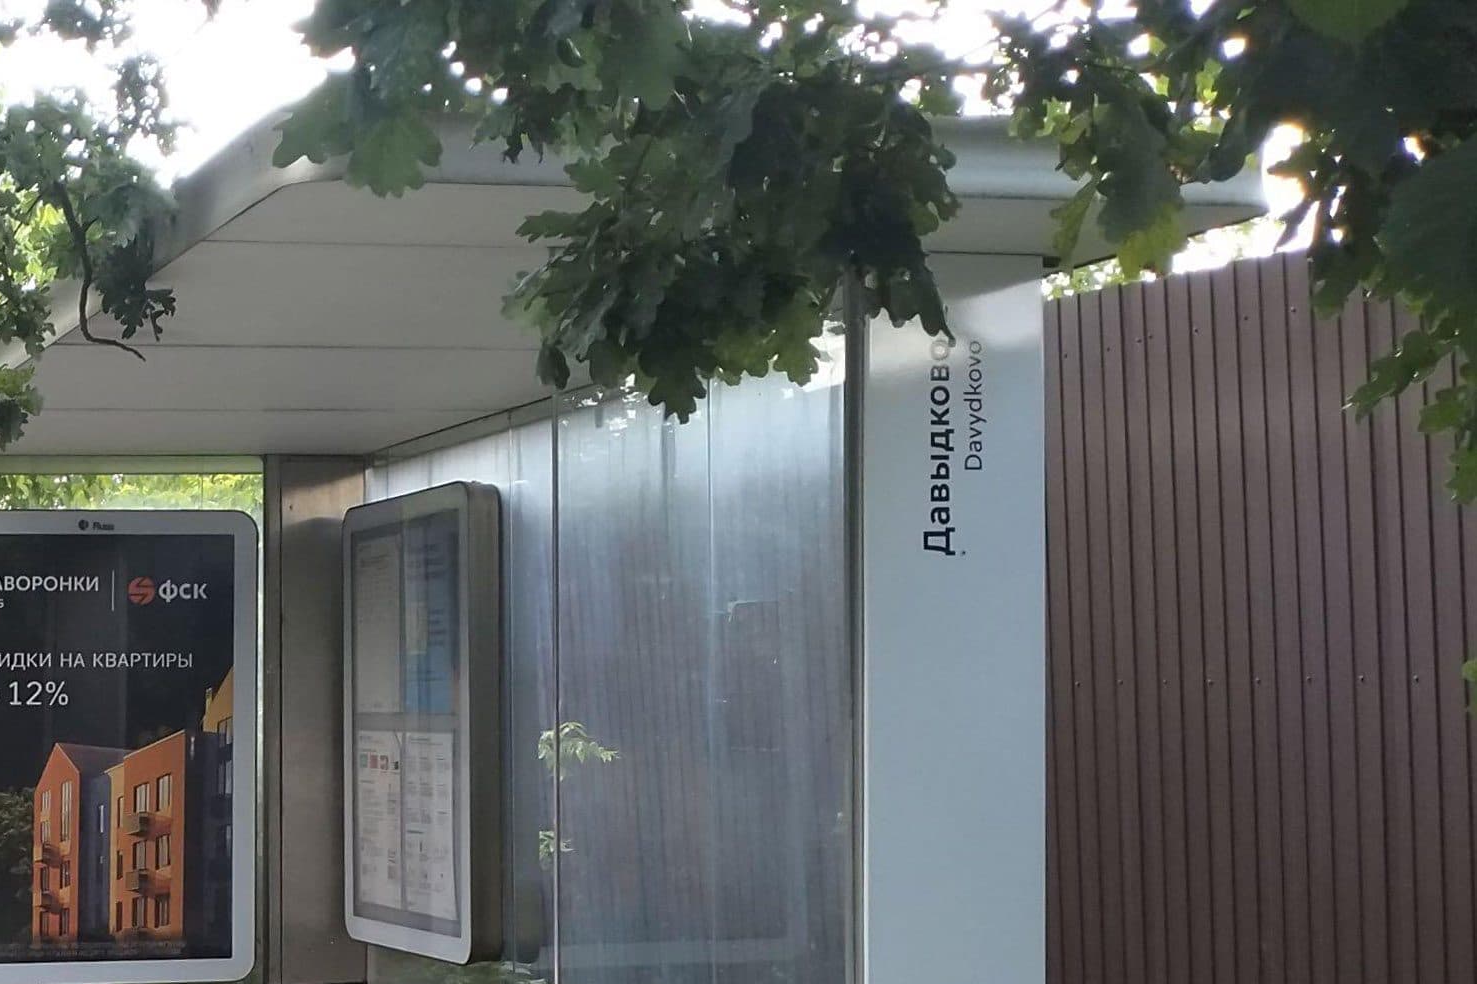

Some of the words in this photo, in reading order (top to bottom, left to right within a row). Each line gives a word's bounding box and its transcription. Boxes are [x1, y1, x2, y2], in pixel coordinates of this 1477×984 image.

[963, 340, 986, 470] Davydkovo
[923, 339, 955, 555] Давыдково
[158, 579, 208, 603] ФСК
[60, 652, 85, 668] НА
[92, 652, 193, 669] КВАРТИРЫ
[8, 680, 69, 706] 12%
